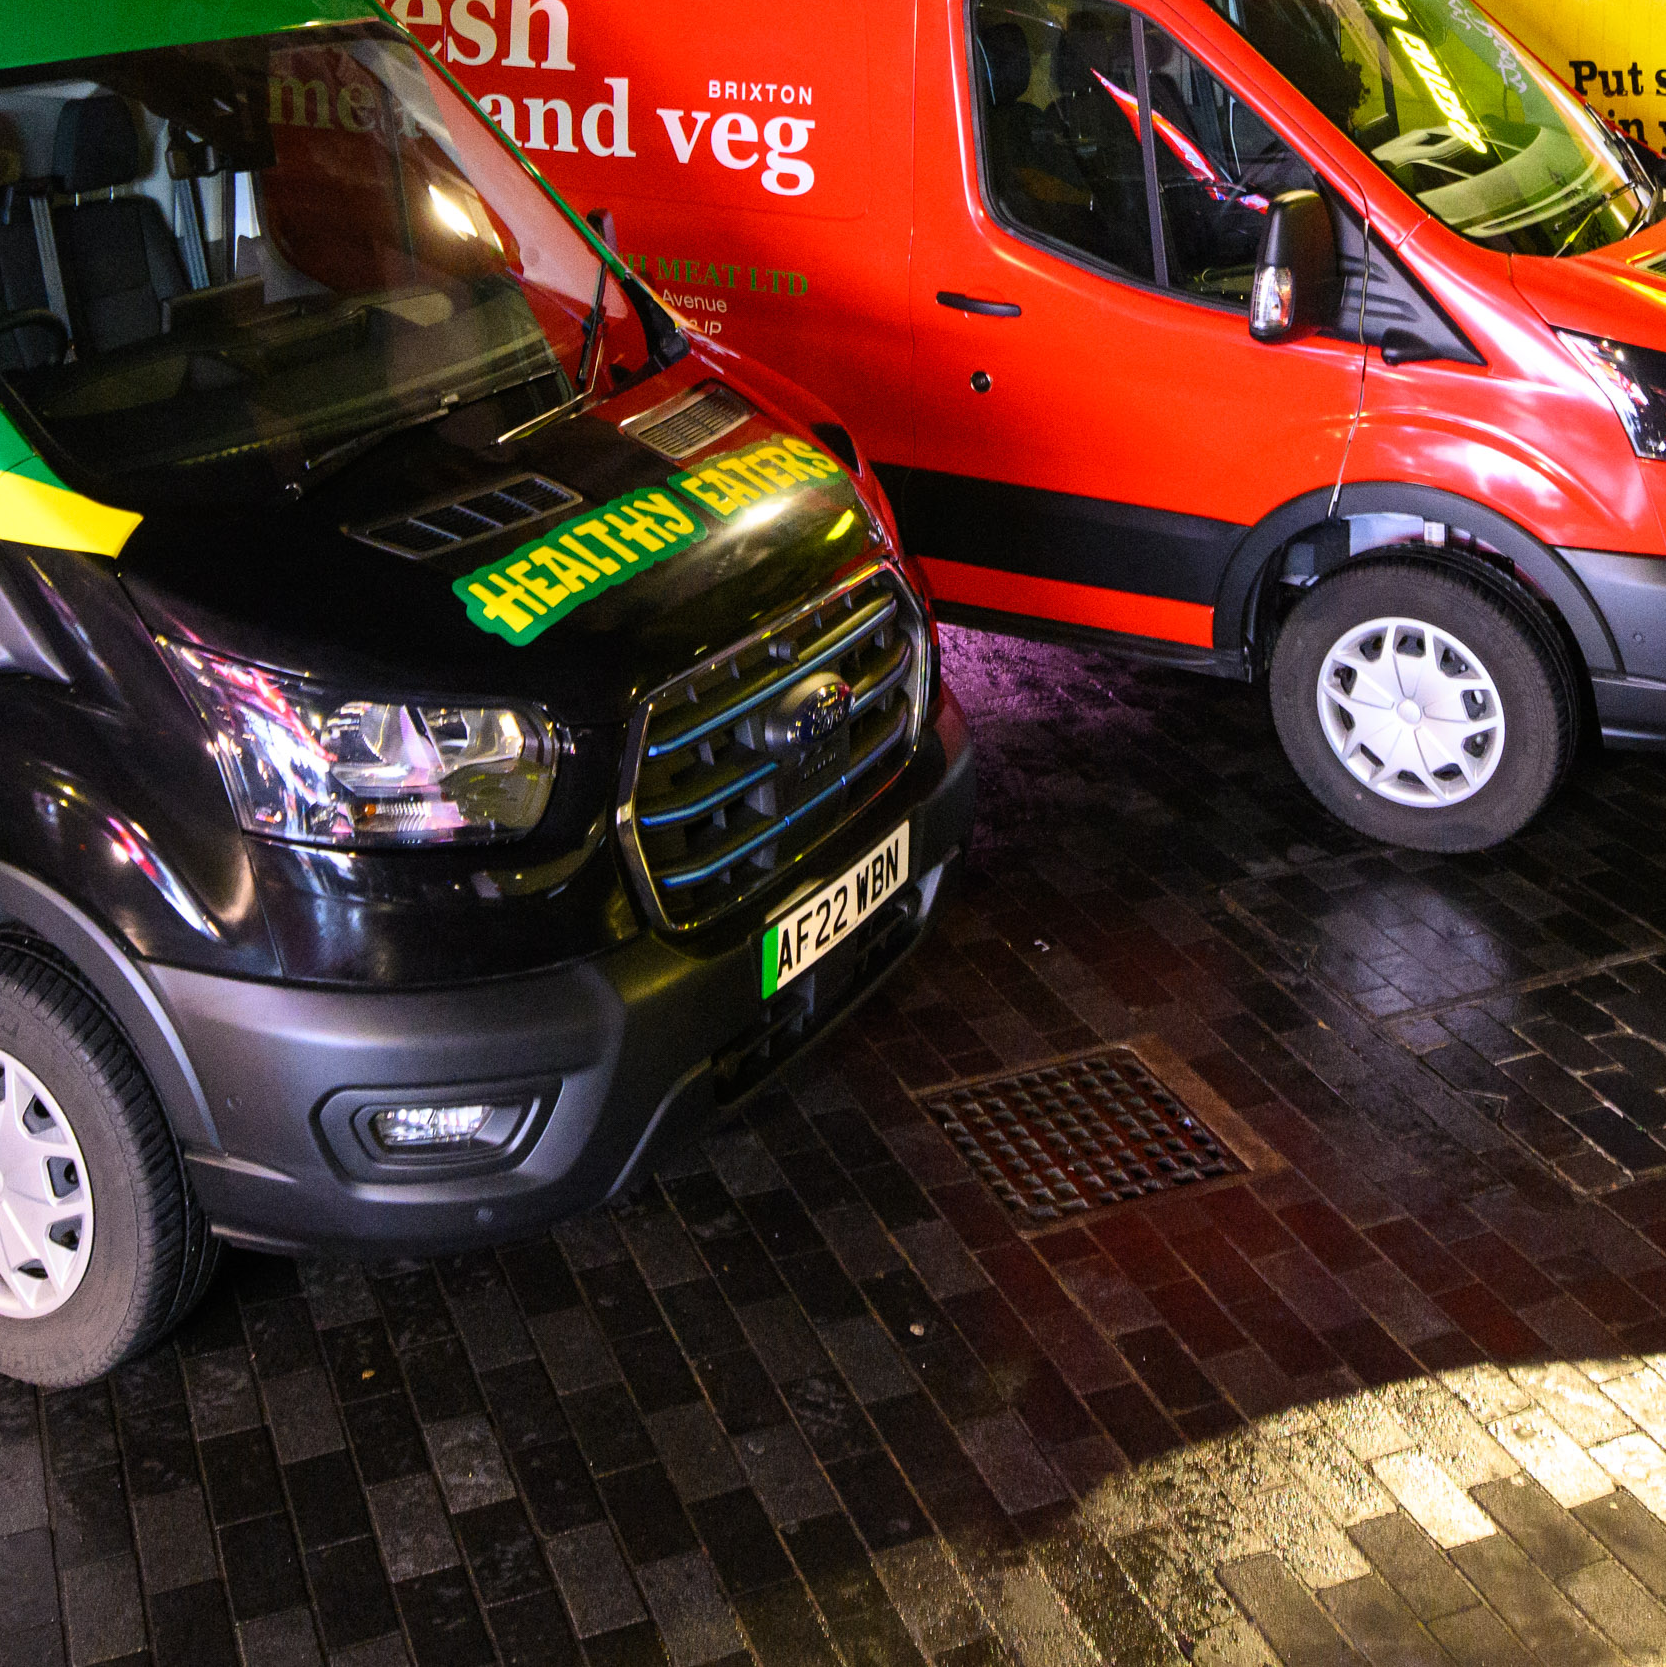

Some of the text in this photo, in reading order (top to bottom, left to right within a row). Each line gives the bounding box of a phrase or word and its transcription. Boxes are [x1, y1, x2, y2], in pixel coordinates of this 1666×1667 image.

[708, 80, 813, 106] BRIXTON
[1568, 60, 1644, 98] Put
[478, 77, 817, 197] and veg
[655, 256, 742, 289] MEAT
[748, 267, 809, 296] LTD
[661, 289, 728, 314] Avenue
[467, 437, 841, 634] HEALTHY EATERS
[777, 884, 849, 980] AF22
[855, 837, 900, 918] WBN
